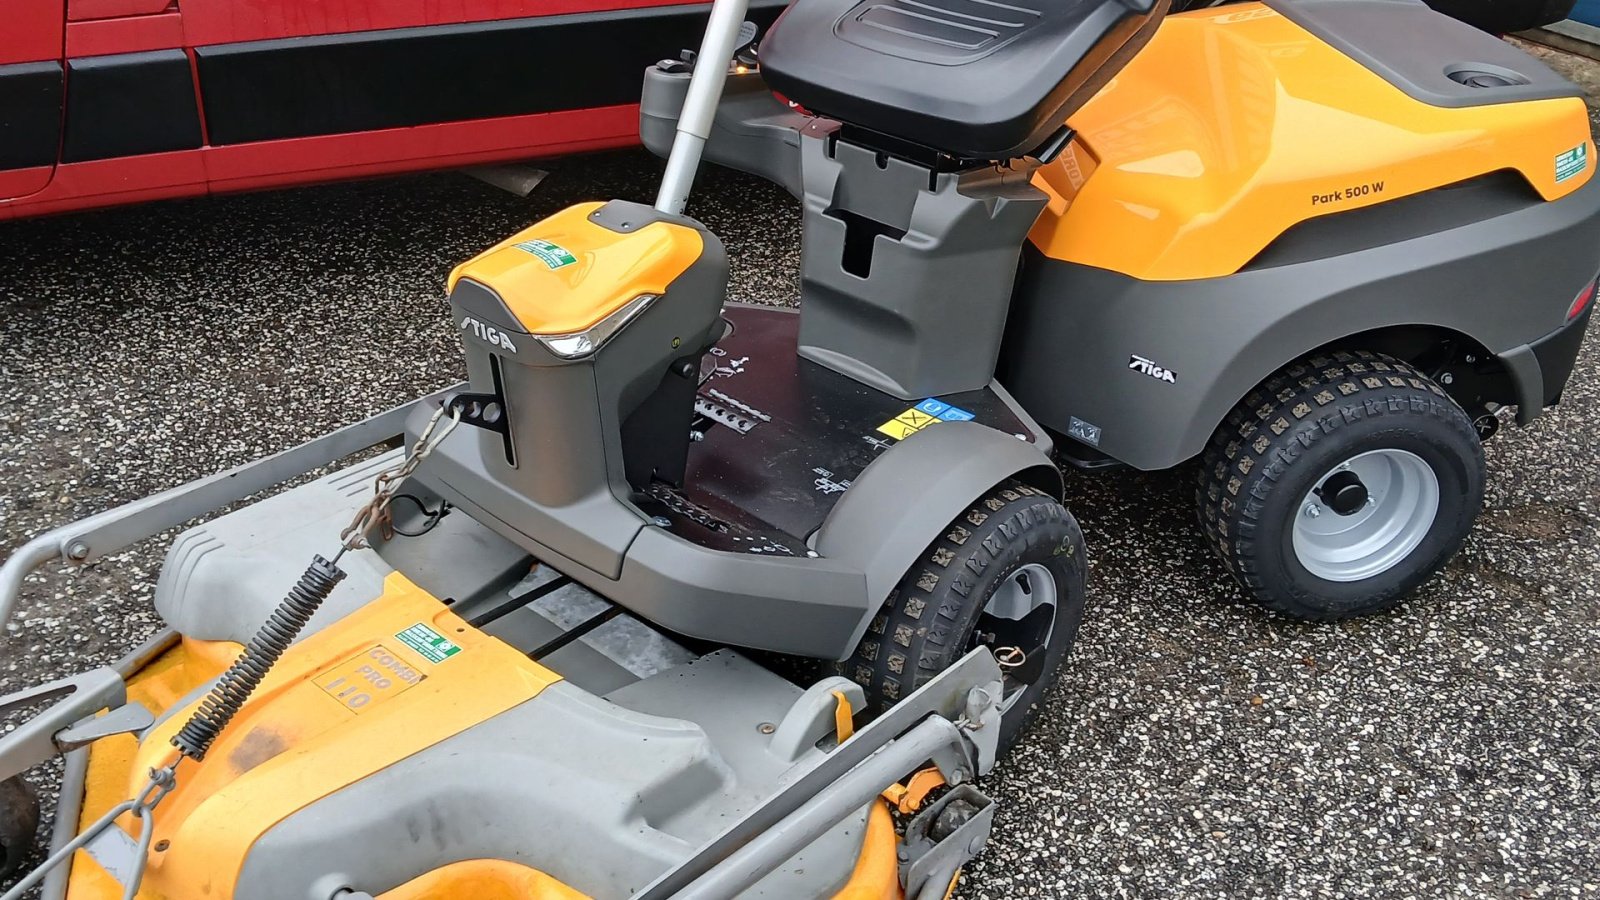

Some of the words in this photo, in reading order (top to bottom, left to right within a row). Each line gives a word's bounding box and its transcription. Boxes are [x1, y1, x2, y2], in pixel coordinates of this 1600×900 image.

[1312, 191, 1342, 205] Park
[1345, 185, 1369, 198] 500
[1372, 181, 1384, 193] W
[461, 317, 517, 354] STIGA
[1129, 354, 1175, 383] STIGA
[355, 664, 392, 689] PRO
[370, 648, 421, 684] COMBI
